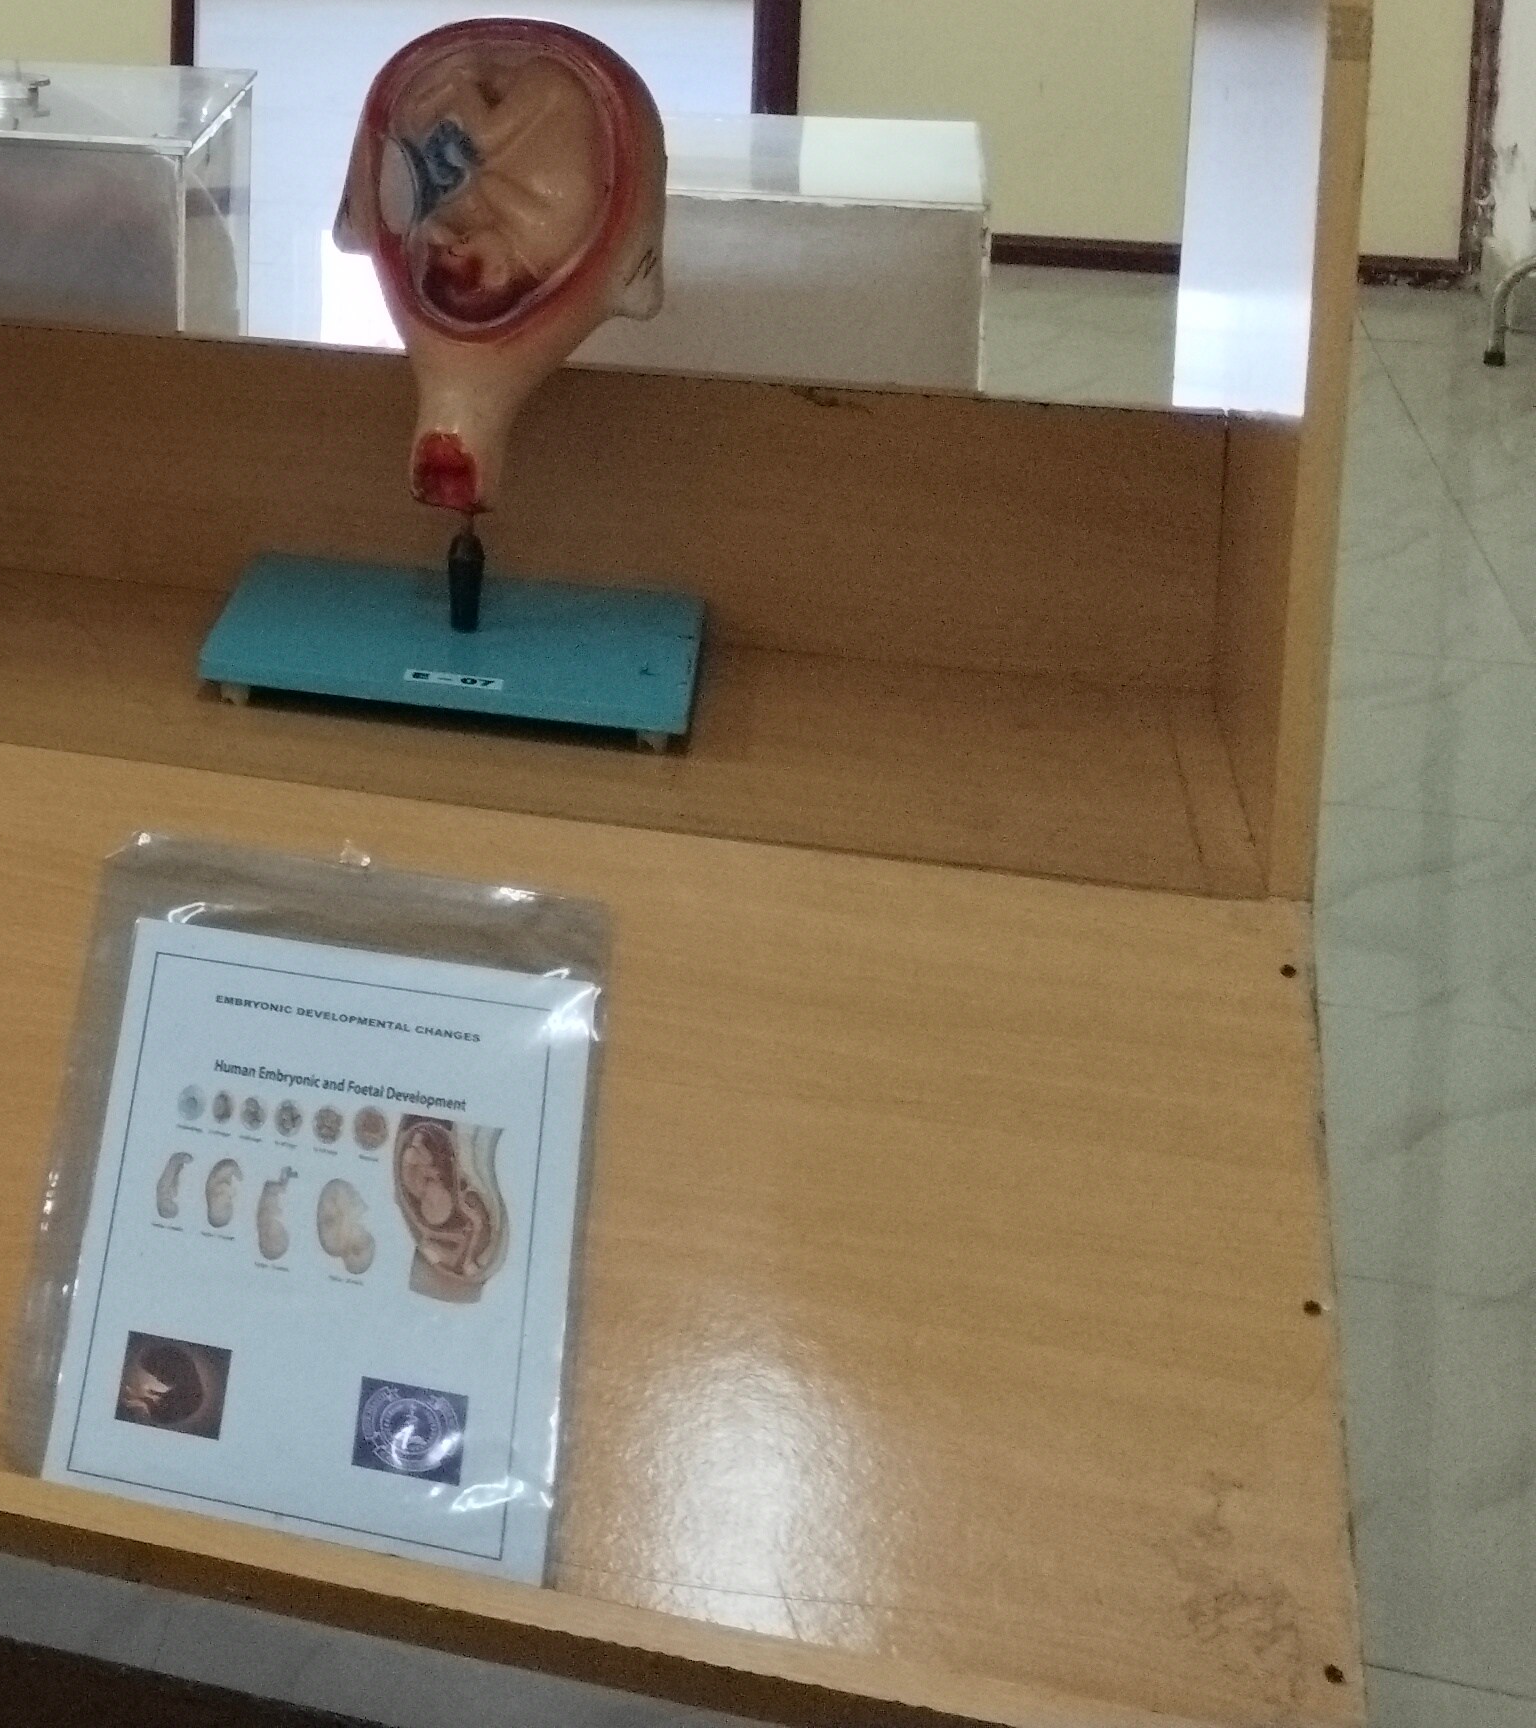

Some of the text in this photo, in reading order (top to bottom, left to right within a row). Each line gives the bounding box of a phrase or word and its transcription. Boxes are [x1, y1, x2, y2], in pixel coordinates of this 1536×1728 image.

[215, 995, 481, 1043] EMBRYONIC DEVELOPMENTAL CHANGES
[214, 1059, 467, 1112] Human Embryonic and Foetal Development
